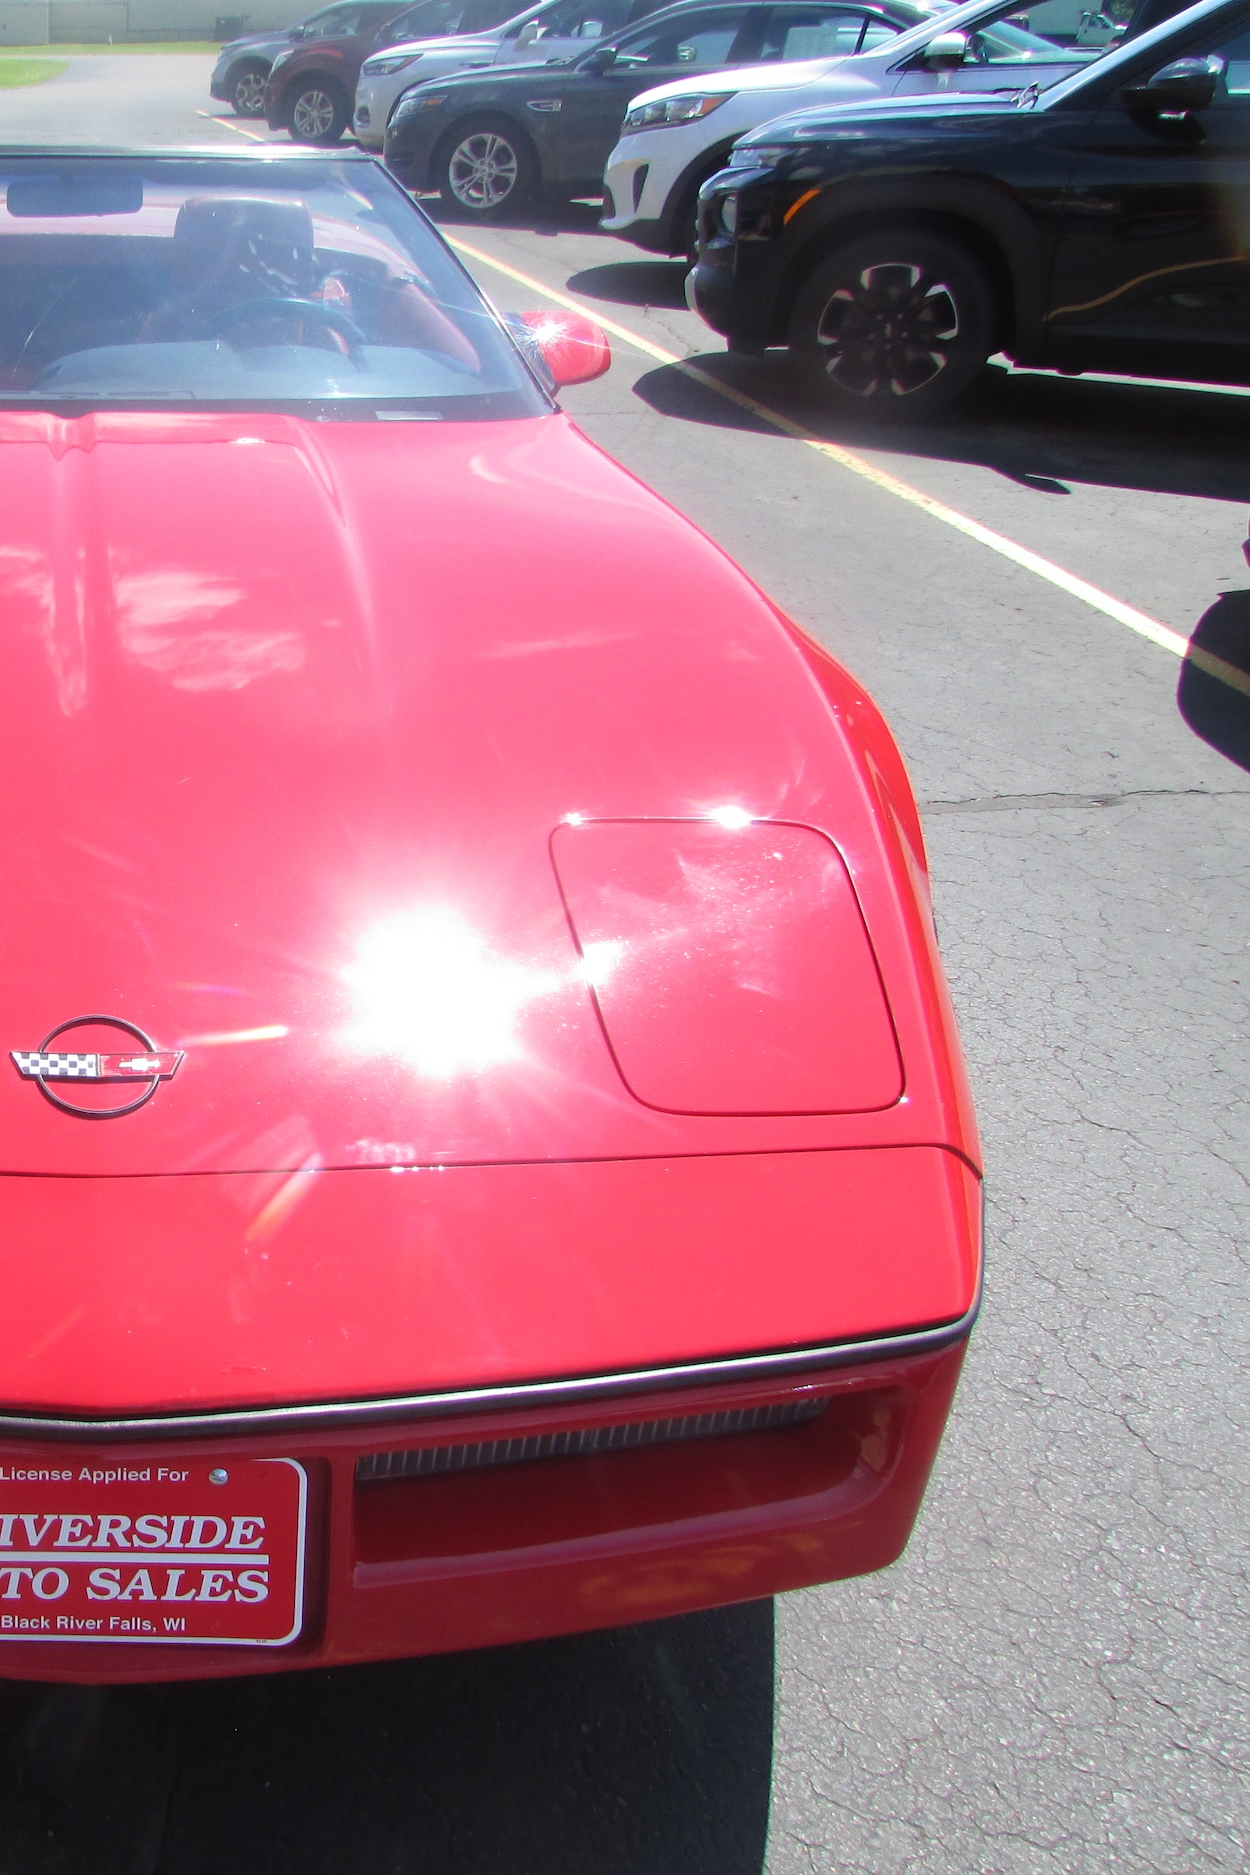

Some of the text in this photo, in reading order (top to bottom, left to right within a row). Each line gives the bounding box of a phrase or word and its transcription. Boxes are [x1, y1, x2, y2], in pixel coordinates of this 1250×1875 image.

[0, 1467, 189, 1484] License Applied For
[86, 1567, 269, 1603] SALES
[1, 1615, 186, 1633] Black River Falls, WI
